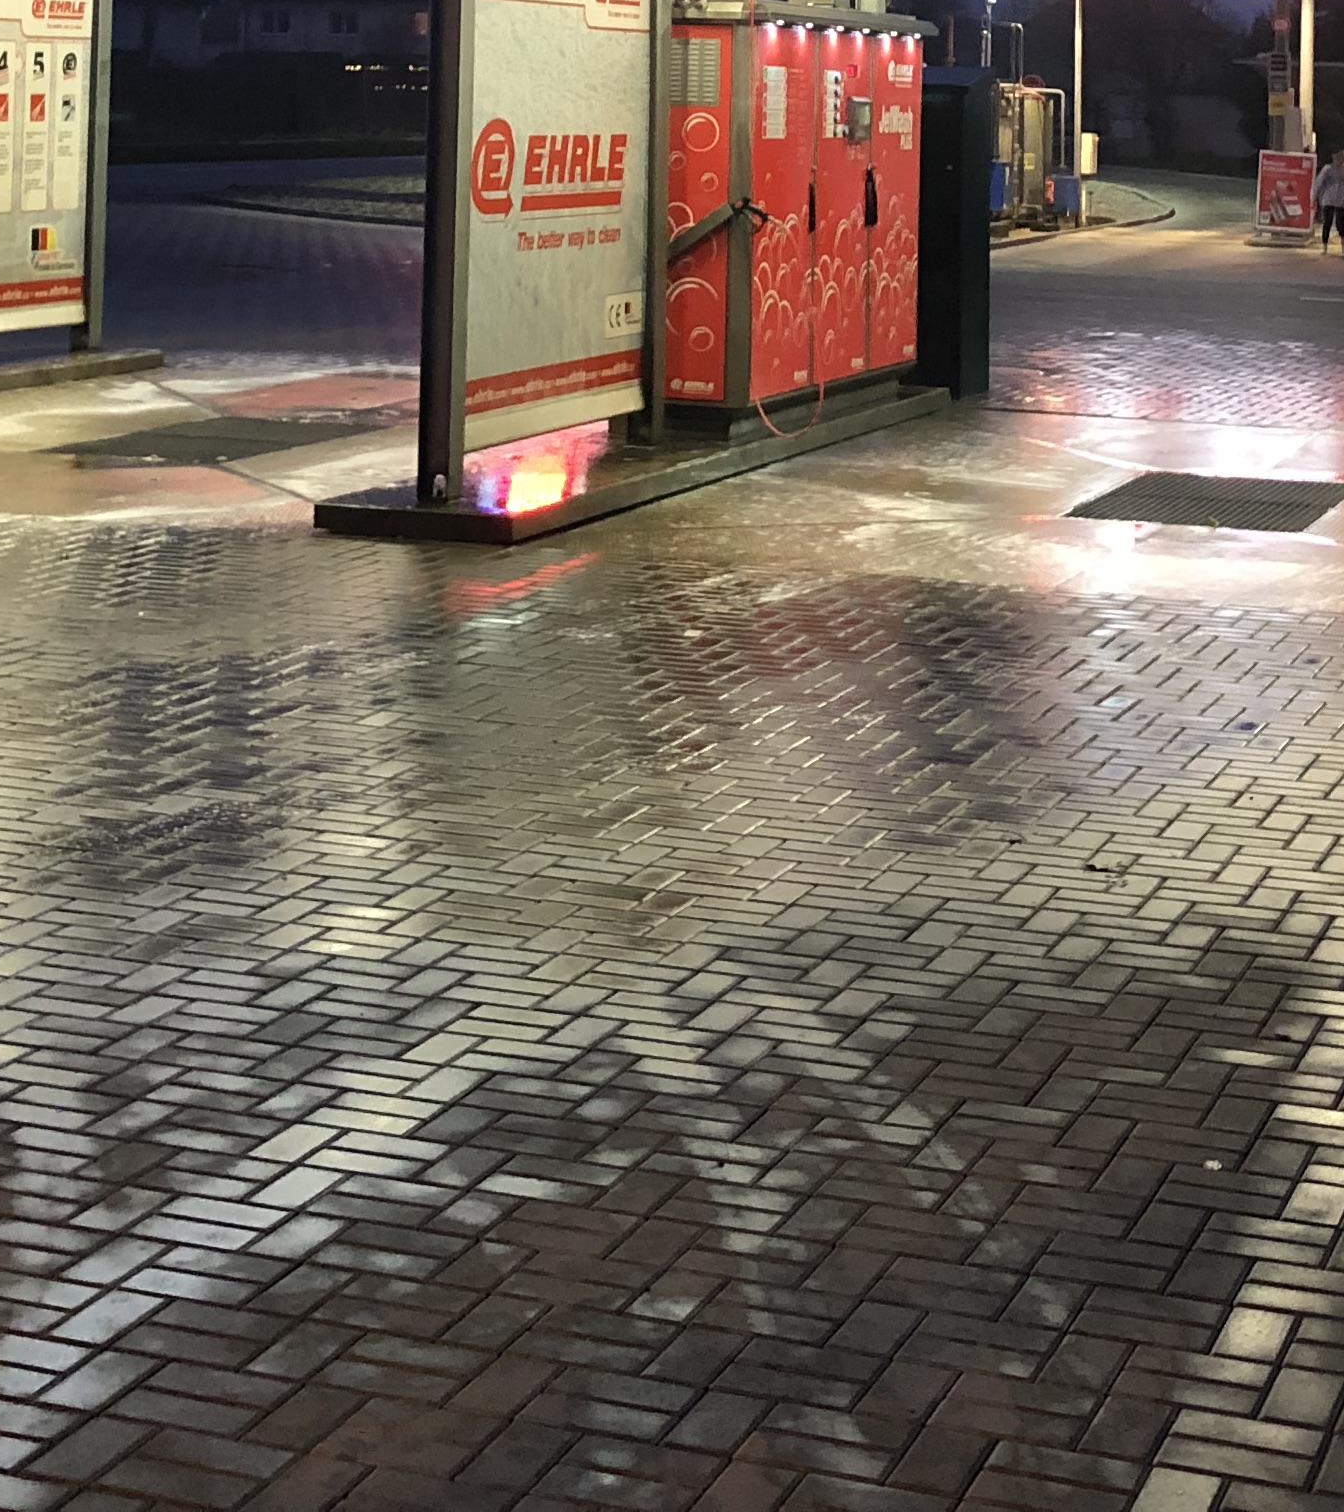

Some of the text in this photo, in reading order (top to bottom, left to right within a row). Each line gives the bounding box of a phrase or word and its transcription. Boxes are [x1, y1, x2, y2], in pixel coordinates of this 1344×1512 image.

[48, 0, 87, 15] EHRLE
[33, 51, 45, 76] 5
[523, 133, 628, 187] EHRLE
[517, 231, 535, 252] The
[537, 229, 565, 251] better
